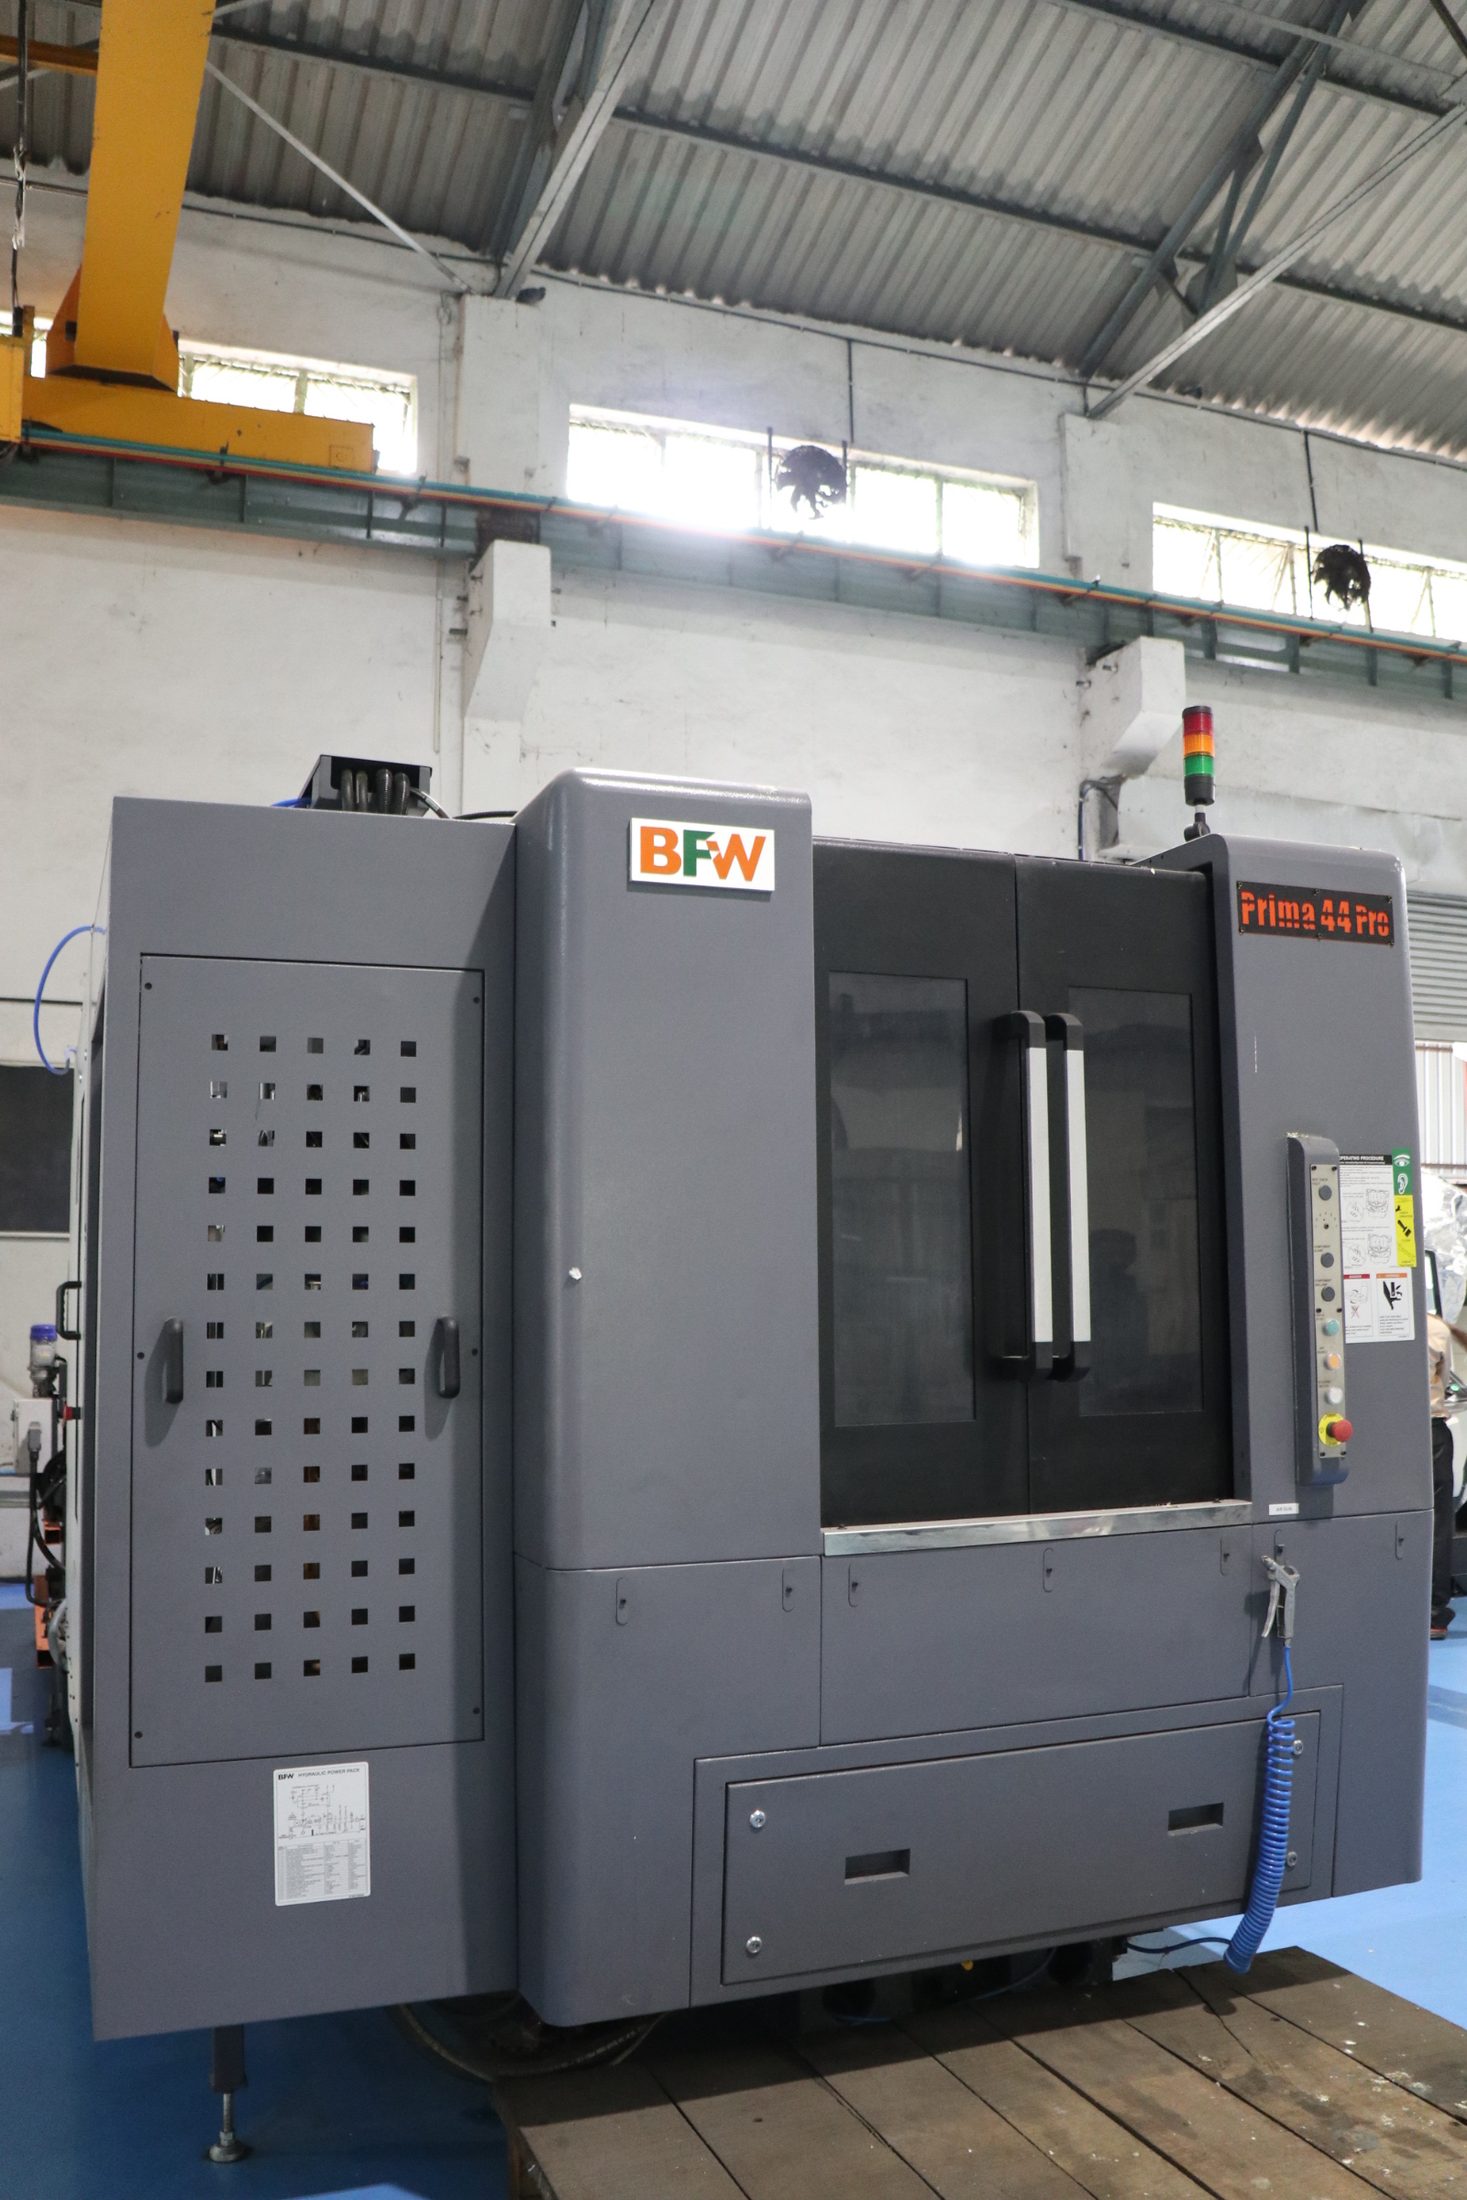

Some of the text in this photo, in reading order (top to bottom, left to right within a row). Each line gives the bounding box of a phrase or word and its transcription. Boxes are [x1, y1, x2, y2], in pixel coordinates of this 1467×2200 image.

[640, 826, 766, 882] BFW
[1240, 891, 1390, 937] Prima 44 Pro
